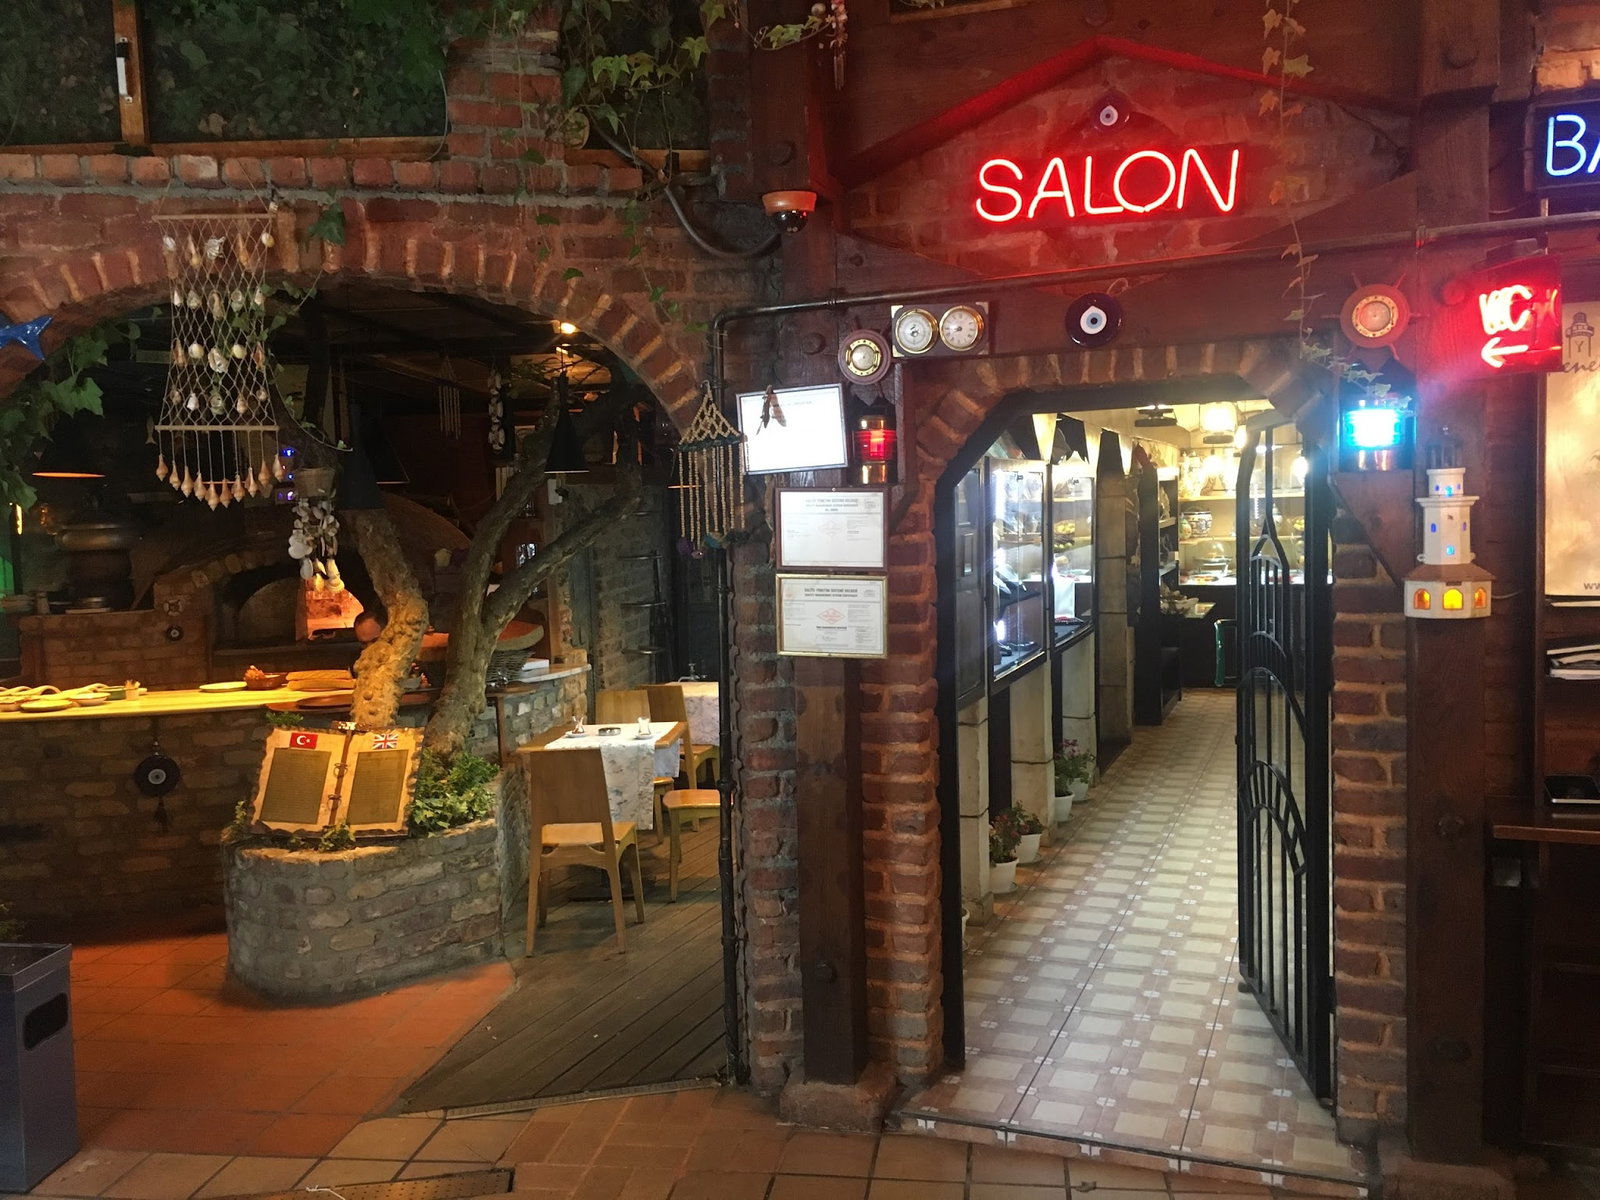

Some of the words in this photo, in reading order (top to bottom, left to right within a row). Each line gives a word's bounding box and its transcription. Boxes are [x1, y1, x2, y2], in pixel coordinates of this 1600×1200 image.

[1546, 114, 1600, 177] B
[975, 149, 1240, 223] SALON
[1478, 284, 1533, 335] WC
